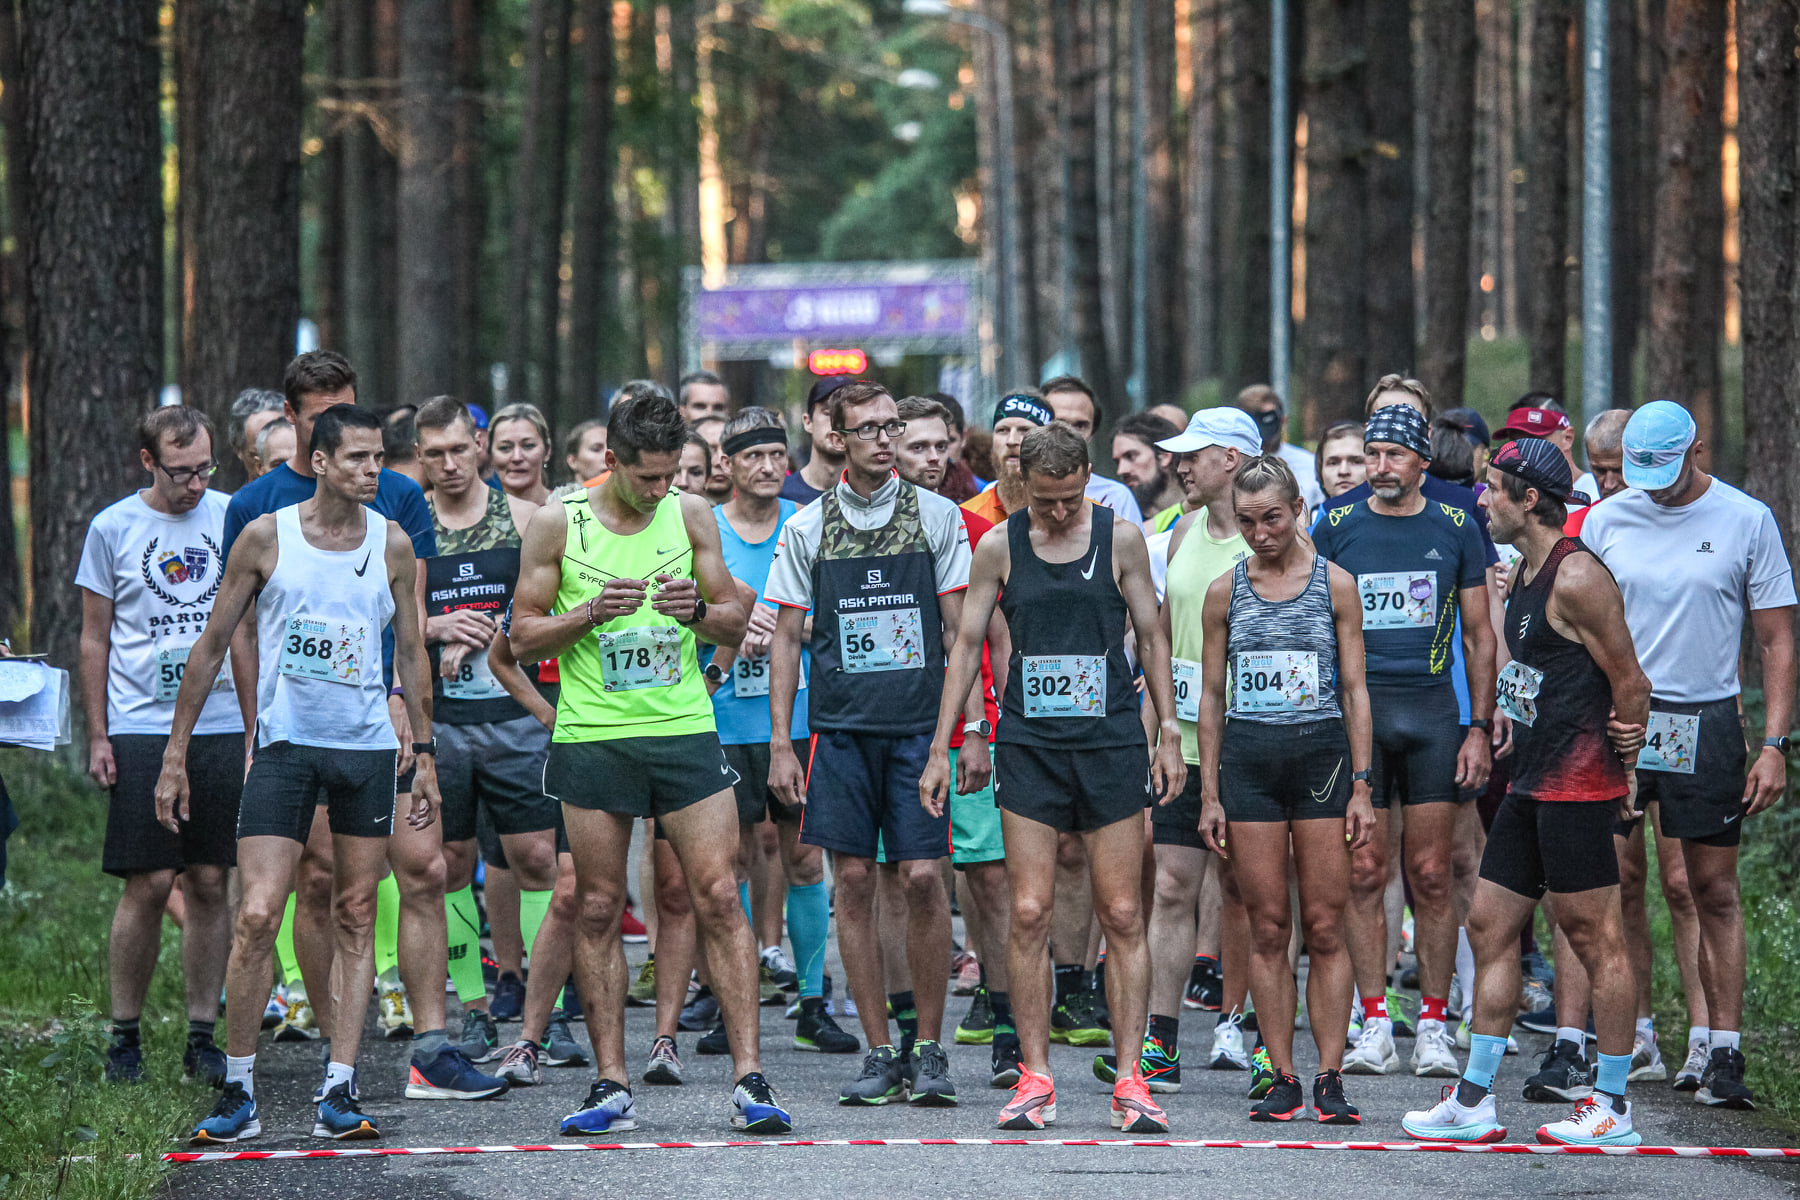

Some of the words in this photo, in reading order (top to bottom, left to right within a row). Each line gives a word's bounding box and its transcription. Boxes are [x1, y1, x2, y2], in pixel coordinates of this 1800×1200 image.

[431, 588, 458, 601] ASK
[460, 583, 506, 598] PATRIA
[860, 582, 890, 590] salomon
[839, 597, 866, 609] ASK
[868, 593, 914, 606] PATRIA
[1364, 591, 1405, 611] 370
[286, 634, 333, 660] 368
[846, 632, 875, 653] 56
[606, 647, 651, 671] 178
[738, 660, 770, 679] 35
[1027, 675, 1072, 697] 302
[1241, 671, 1283, 692] 304
[1590, 1115, 1617, 1138] HOKA
